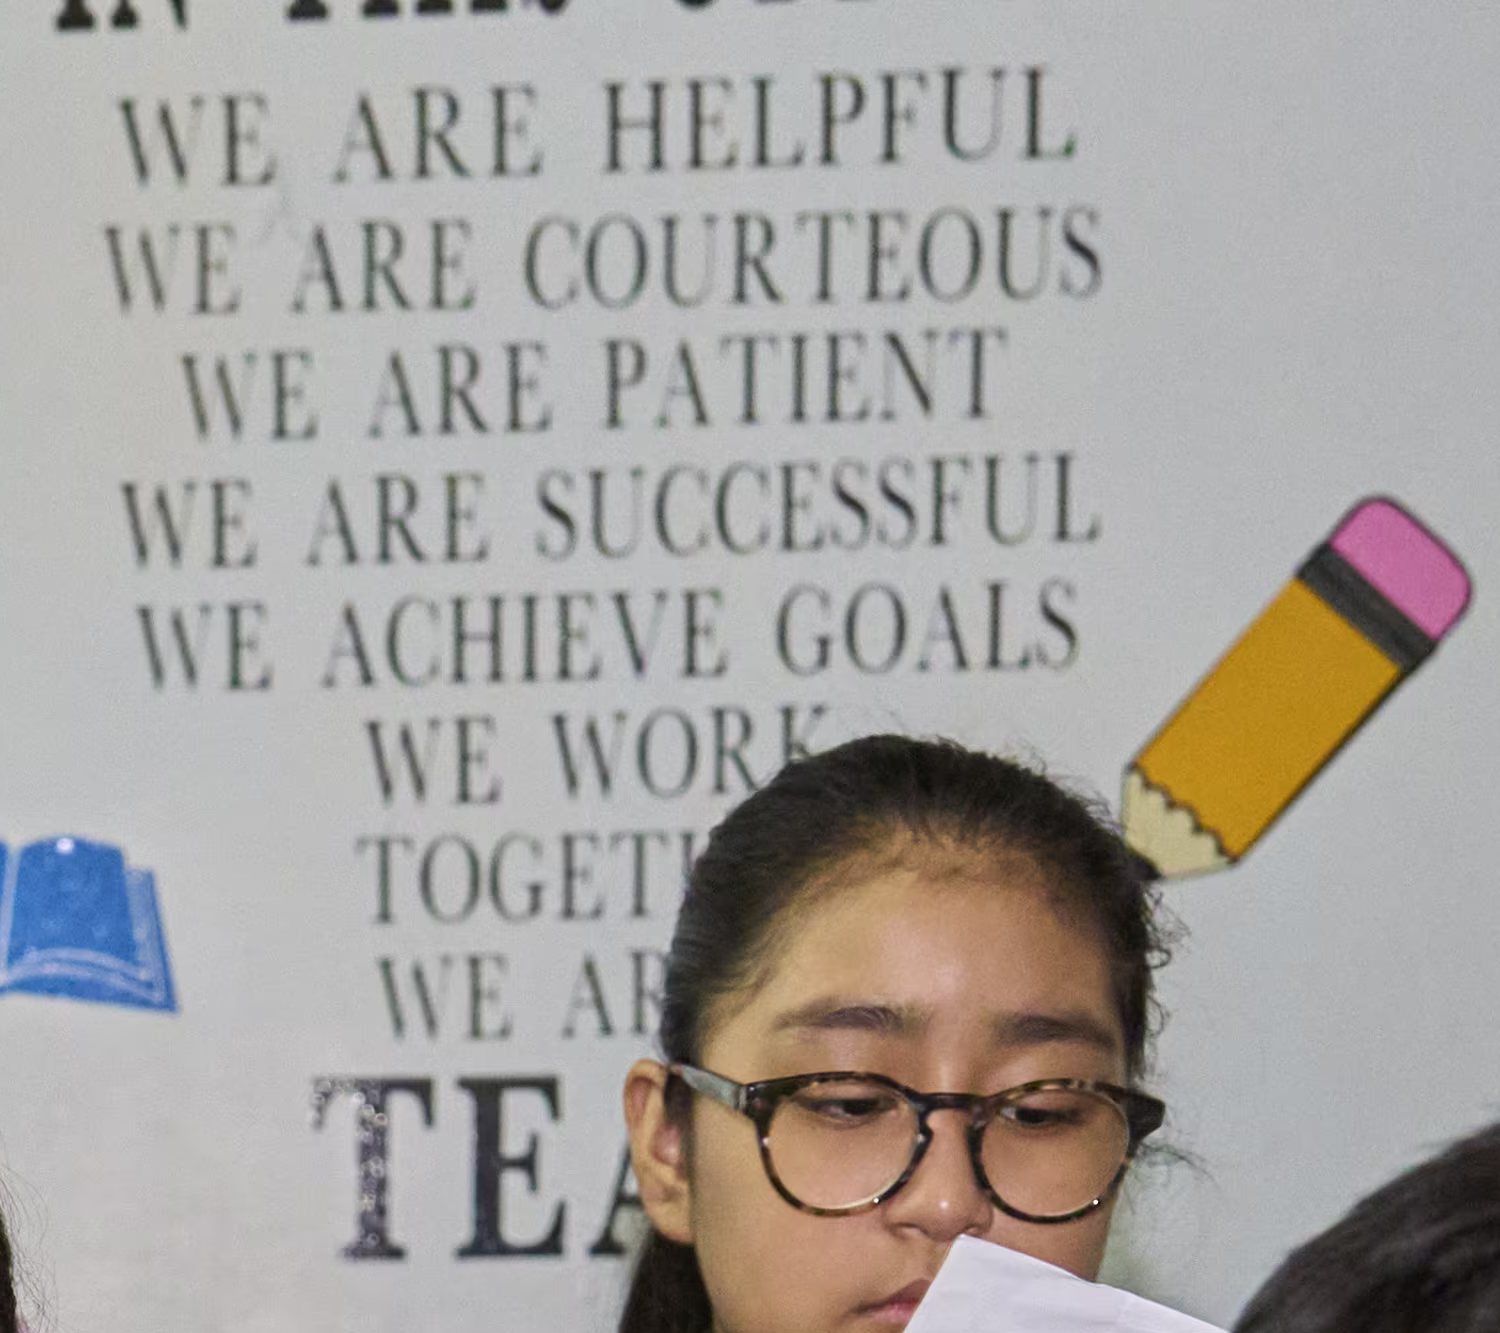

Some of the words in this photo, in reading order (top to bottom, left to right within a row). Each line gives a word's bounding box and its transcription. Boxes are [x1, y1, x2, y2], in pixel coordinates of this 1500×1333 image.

[117, 93, 276, 188] WE
[333, 84, 543, 184] ARE
[603, 65, 1077, 175] HELPFUL
[103, 223, 240, 316] WE
[291, 219, 476, 314] ARE
[522, 206, 1103, 310] COURTEOUS
[180, 350, 318, 442] WE
[368, 342, 552, 439] ARE
[604, 328, 1007, 431] PATIENT
[120, 478, 257, 570] WE
[306, 472, 489, 567] ARE
[536, 451, 1100, 559] SUCCESSFUL
[136, 601, 272, 692] WE
[322, 588, 728, 689] ACHIEVE
[774, 579, 1079, 675] GOALS
[364, 715, 501, 806] WE
[356, 828, 695, 924] TOGET
[377, 953, 512, 1042] WE
[562, 949, 667, 1040] AR
